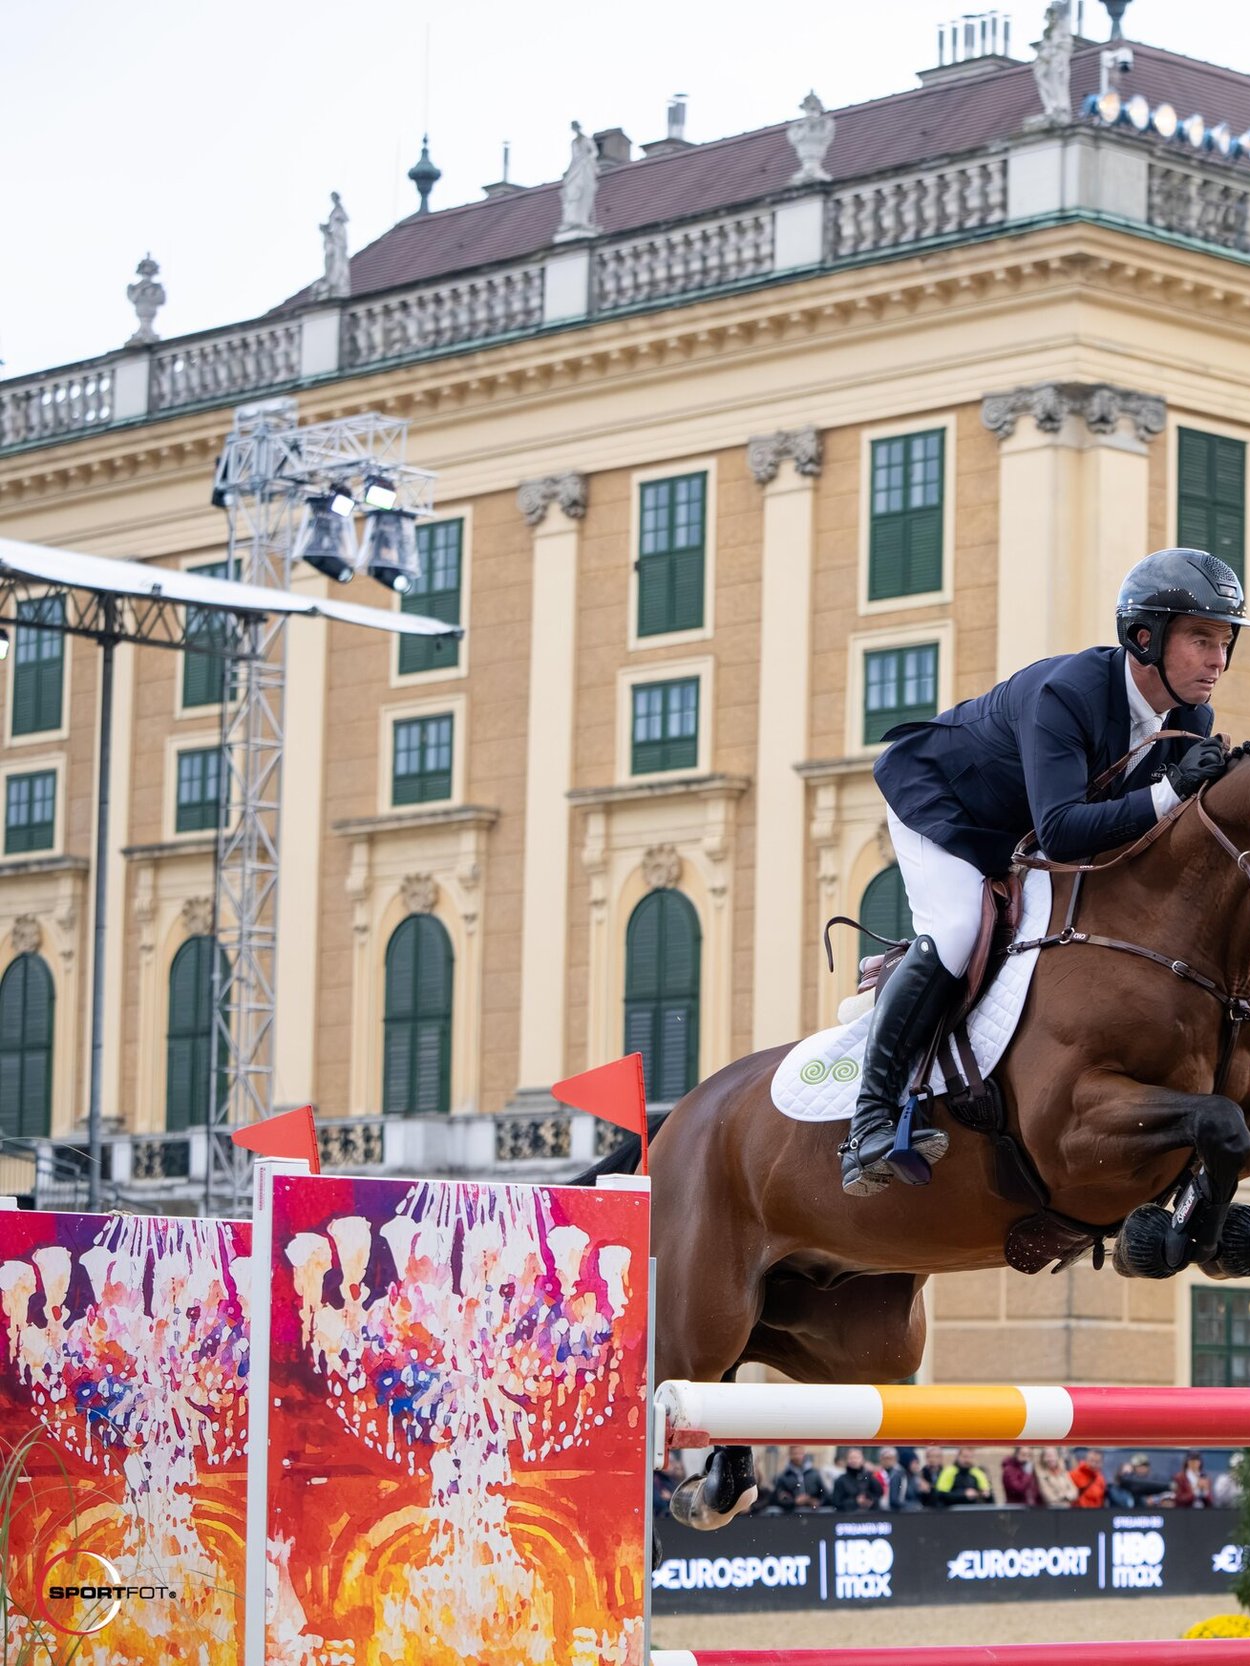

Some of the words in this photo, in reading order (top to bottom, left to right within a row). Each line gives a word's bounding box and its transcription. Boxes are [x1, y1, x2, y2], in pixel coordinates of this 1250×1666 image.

[661, 1555, 811, 1589] EUROSPORT
[835, 1538, 894, 1574] HBO
[957, 1546, 1092, 1579] EUROSPORT
[835, 1573, 893, 1599] max
